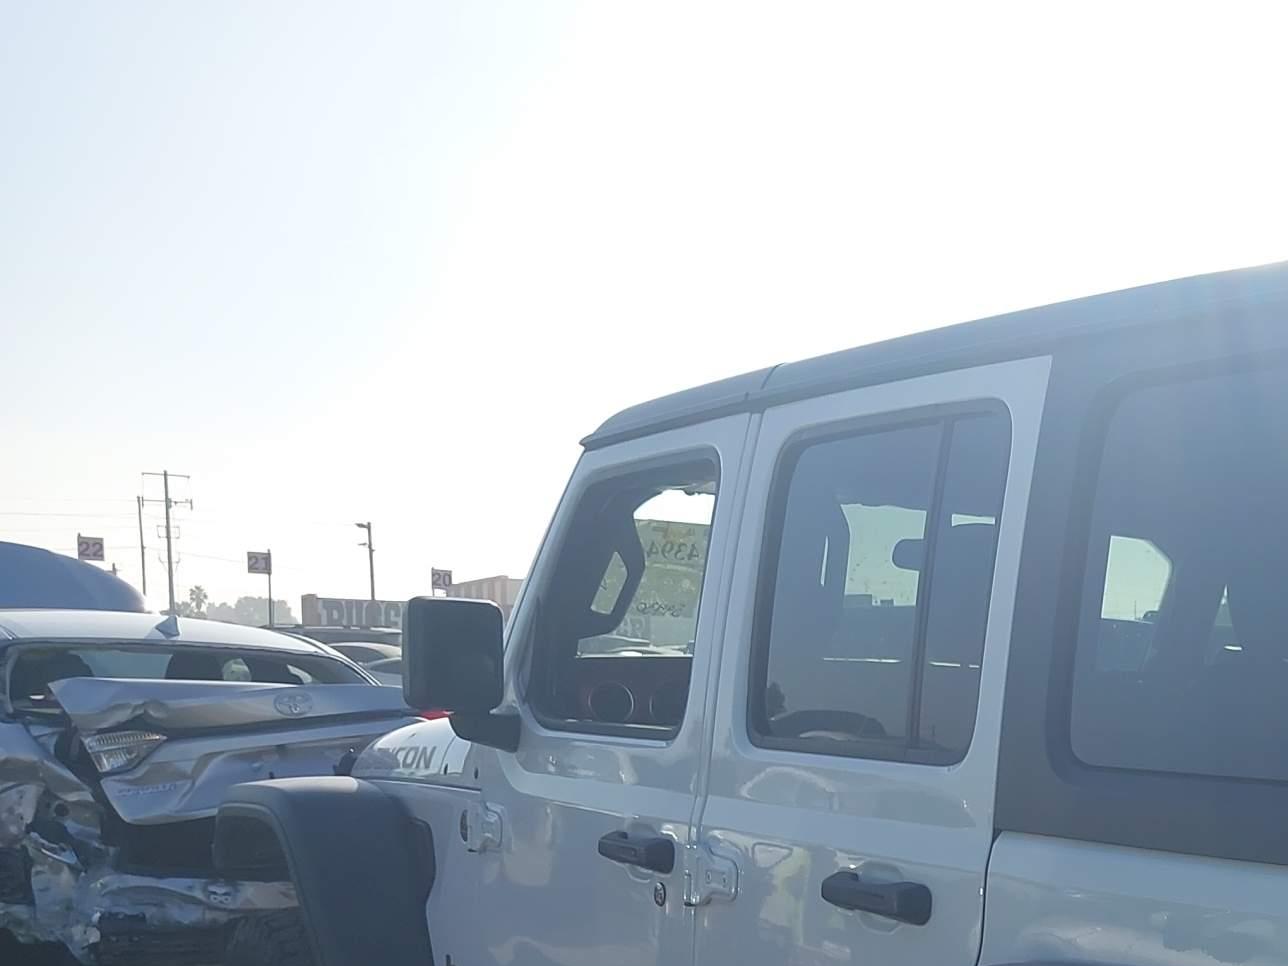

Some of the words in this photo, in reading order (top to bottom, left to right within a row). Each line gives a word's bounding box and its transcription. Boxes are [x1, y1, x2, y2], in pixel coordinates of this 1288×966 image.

[79, 542, 104, 558] 22
[248, 555, 271, 571] 21
[432, 572, 452, 587] 20
